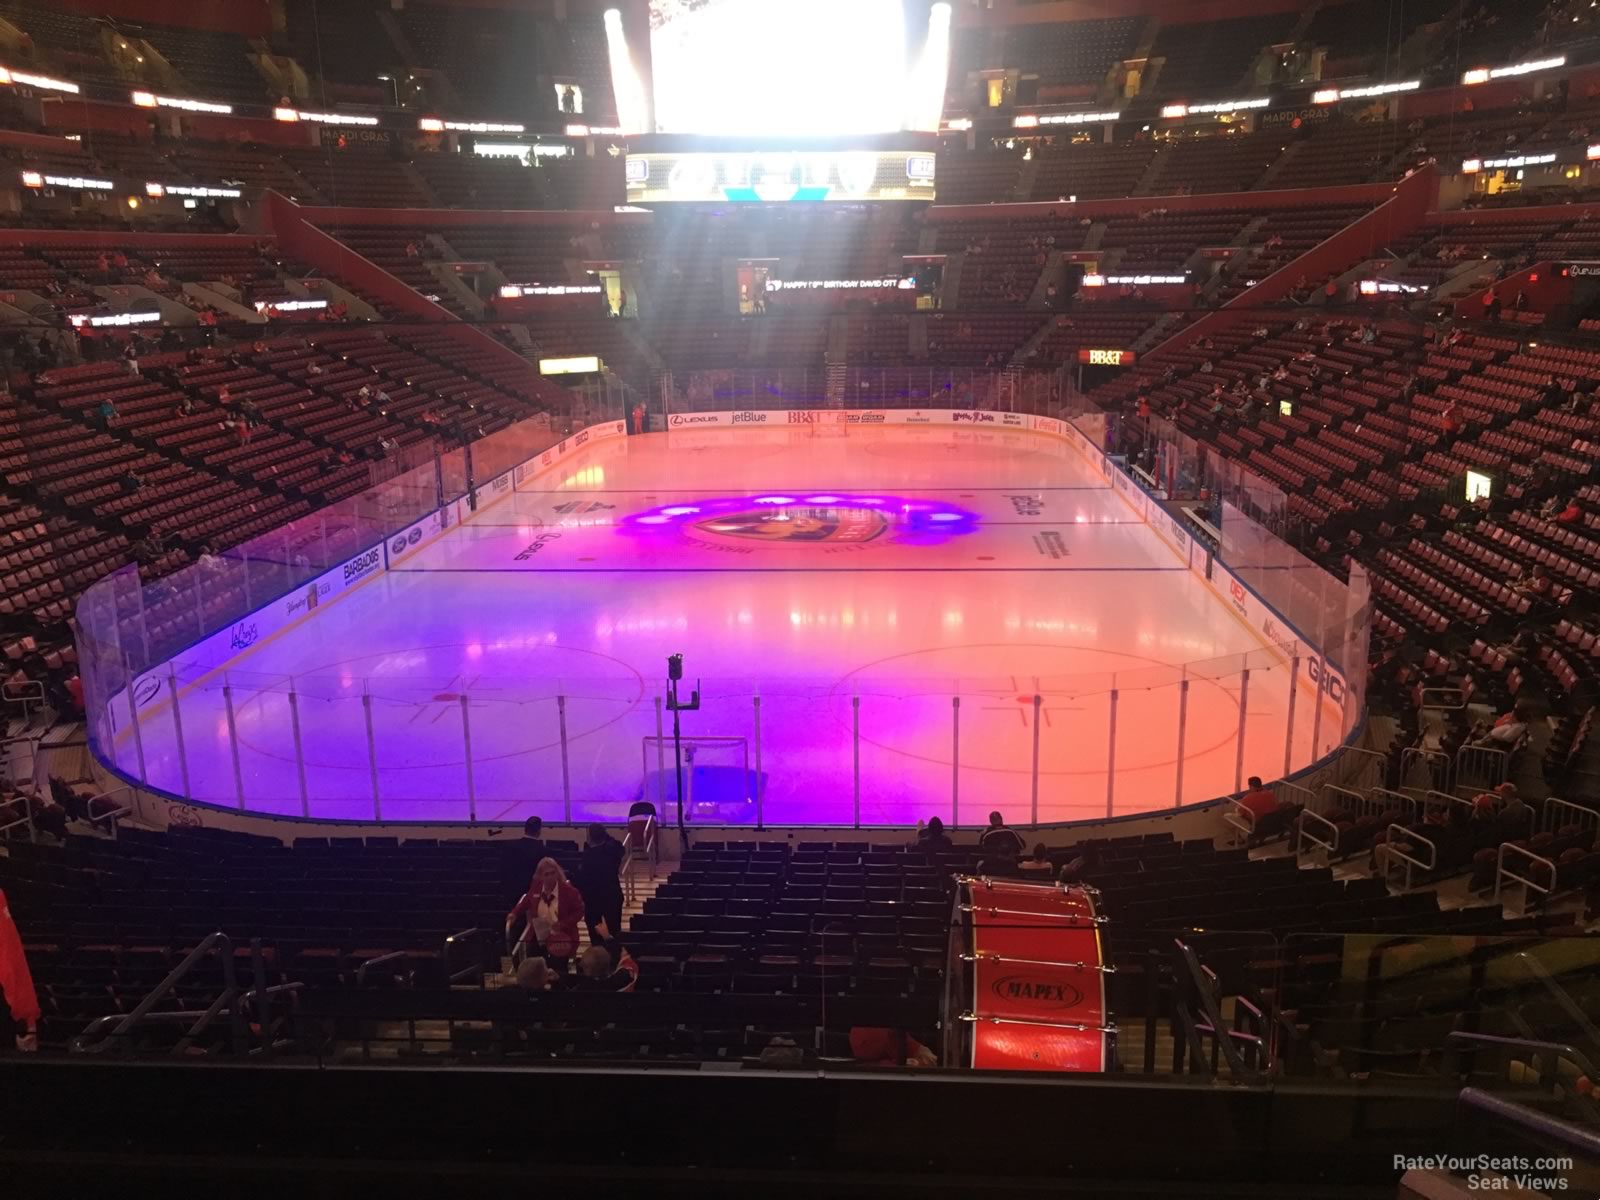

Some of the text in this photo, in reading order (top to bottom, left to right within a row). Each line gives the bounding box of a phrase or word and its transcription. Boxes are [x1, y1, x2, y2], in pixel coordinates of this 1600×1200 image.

[1301, 108, 1330, 120] GRAS
[360, 131, 391, 142] GRAS
[783, 281, 808, 289] HAPPY
[823, 280, 859, 289] BIRTHDAY
[860, 280, 882, 288] DAVID
[1089, 350, 1124, 365] BB&T
[731, 411, 767, 425] jetBlue
[343, 548, 380, 580] BARBADOS
[1007, 982, 1067, 1001] MAPEX
